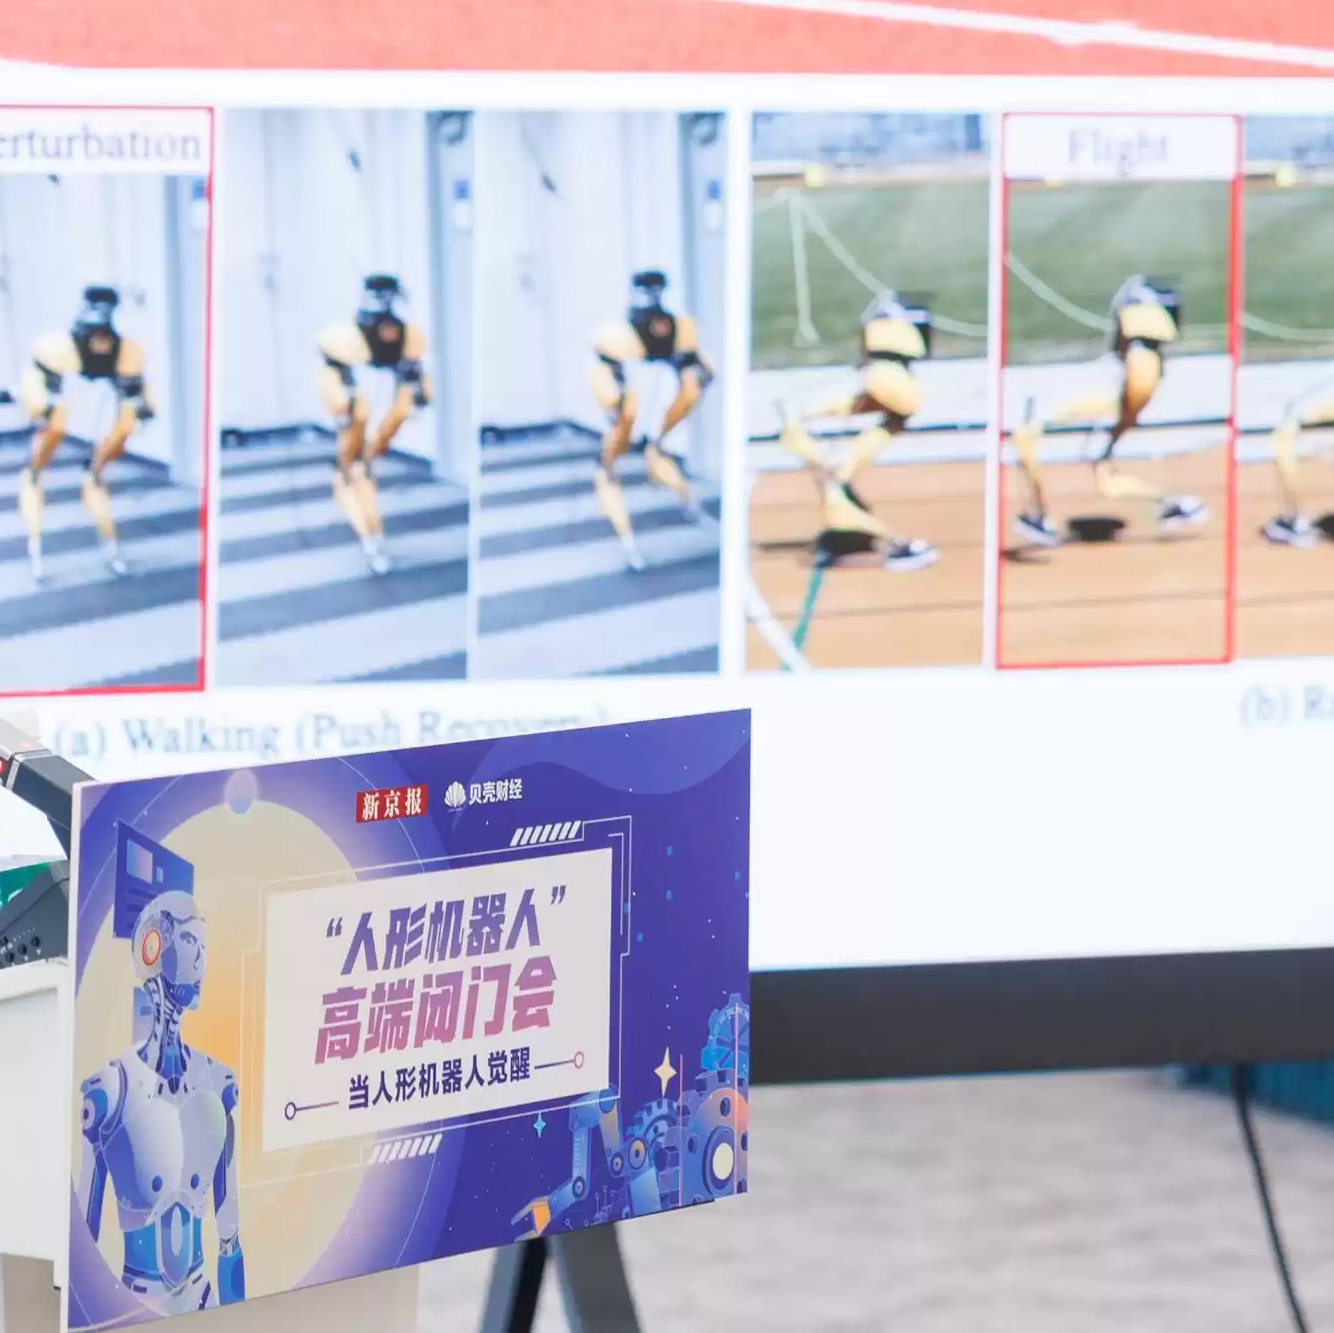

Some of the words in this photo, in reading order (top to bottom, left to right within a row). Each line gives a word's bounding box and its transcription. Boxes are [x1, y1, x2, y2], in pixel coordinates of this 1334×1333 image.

[1067, 126, 1169, 177] Flight
[55, 718, 108, 765] (a)
[121, 713, 281, 761] Walking
[296, 709, 402, 752] (Push
[362, 787, 422, 820] 新京报
[469, 778, 523, 805] 贝壳财经
[314, 955, 557, 1065] 高端闭门会
[348, 1046, 531, 1109] 当人形机器人觉醒
